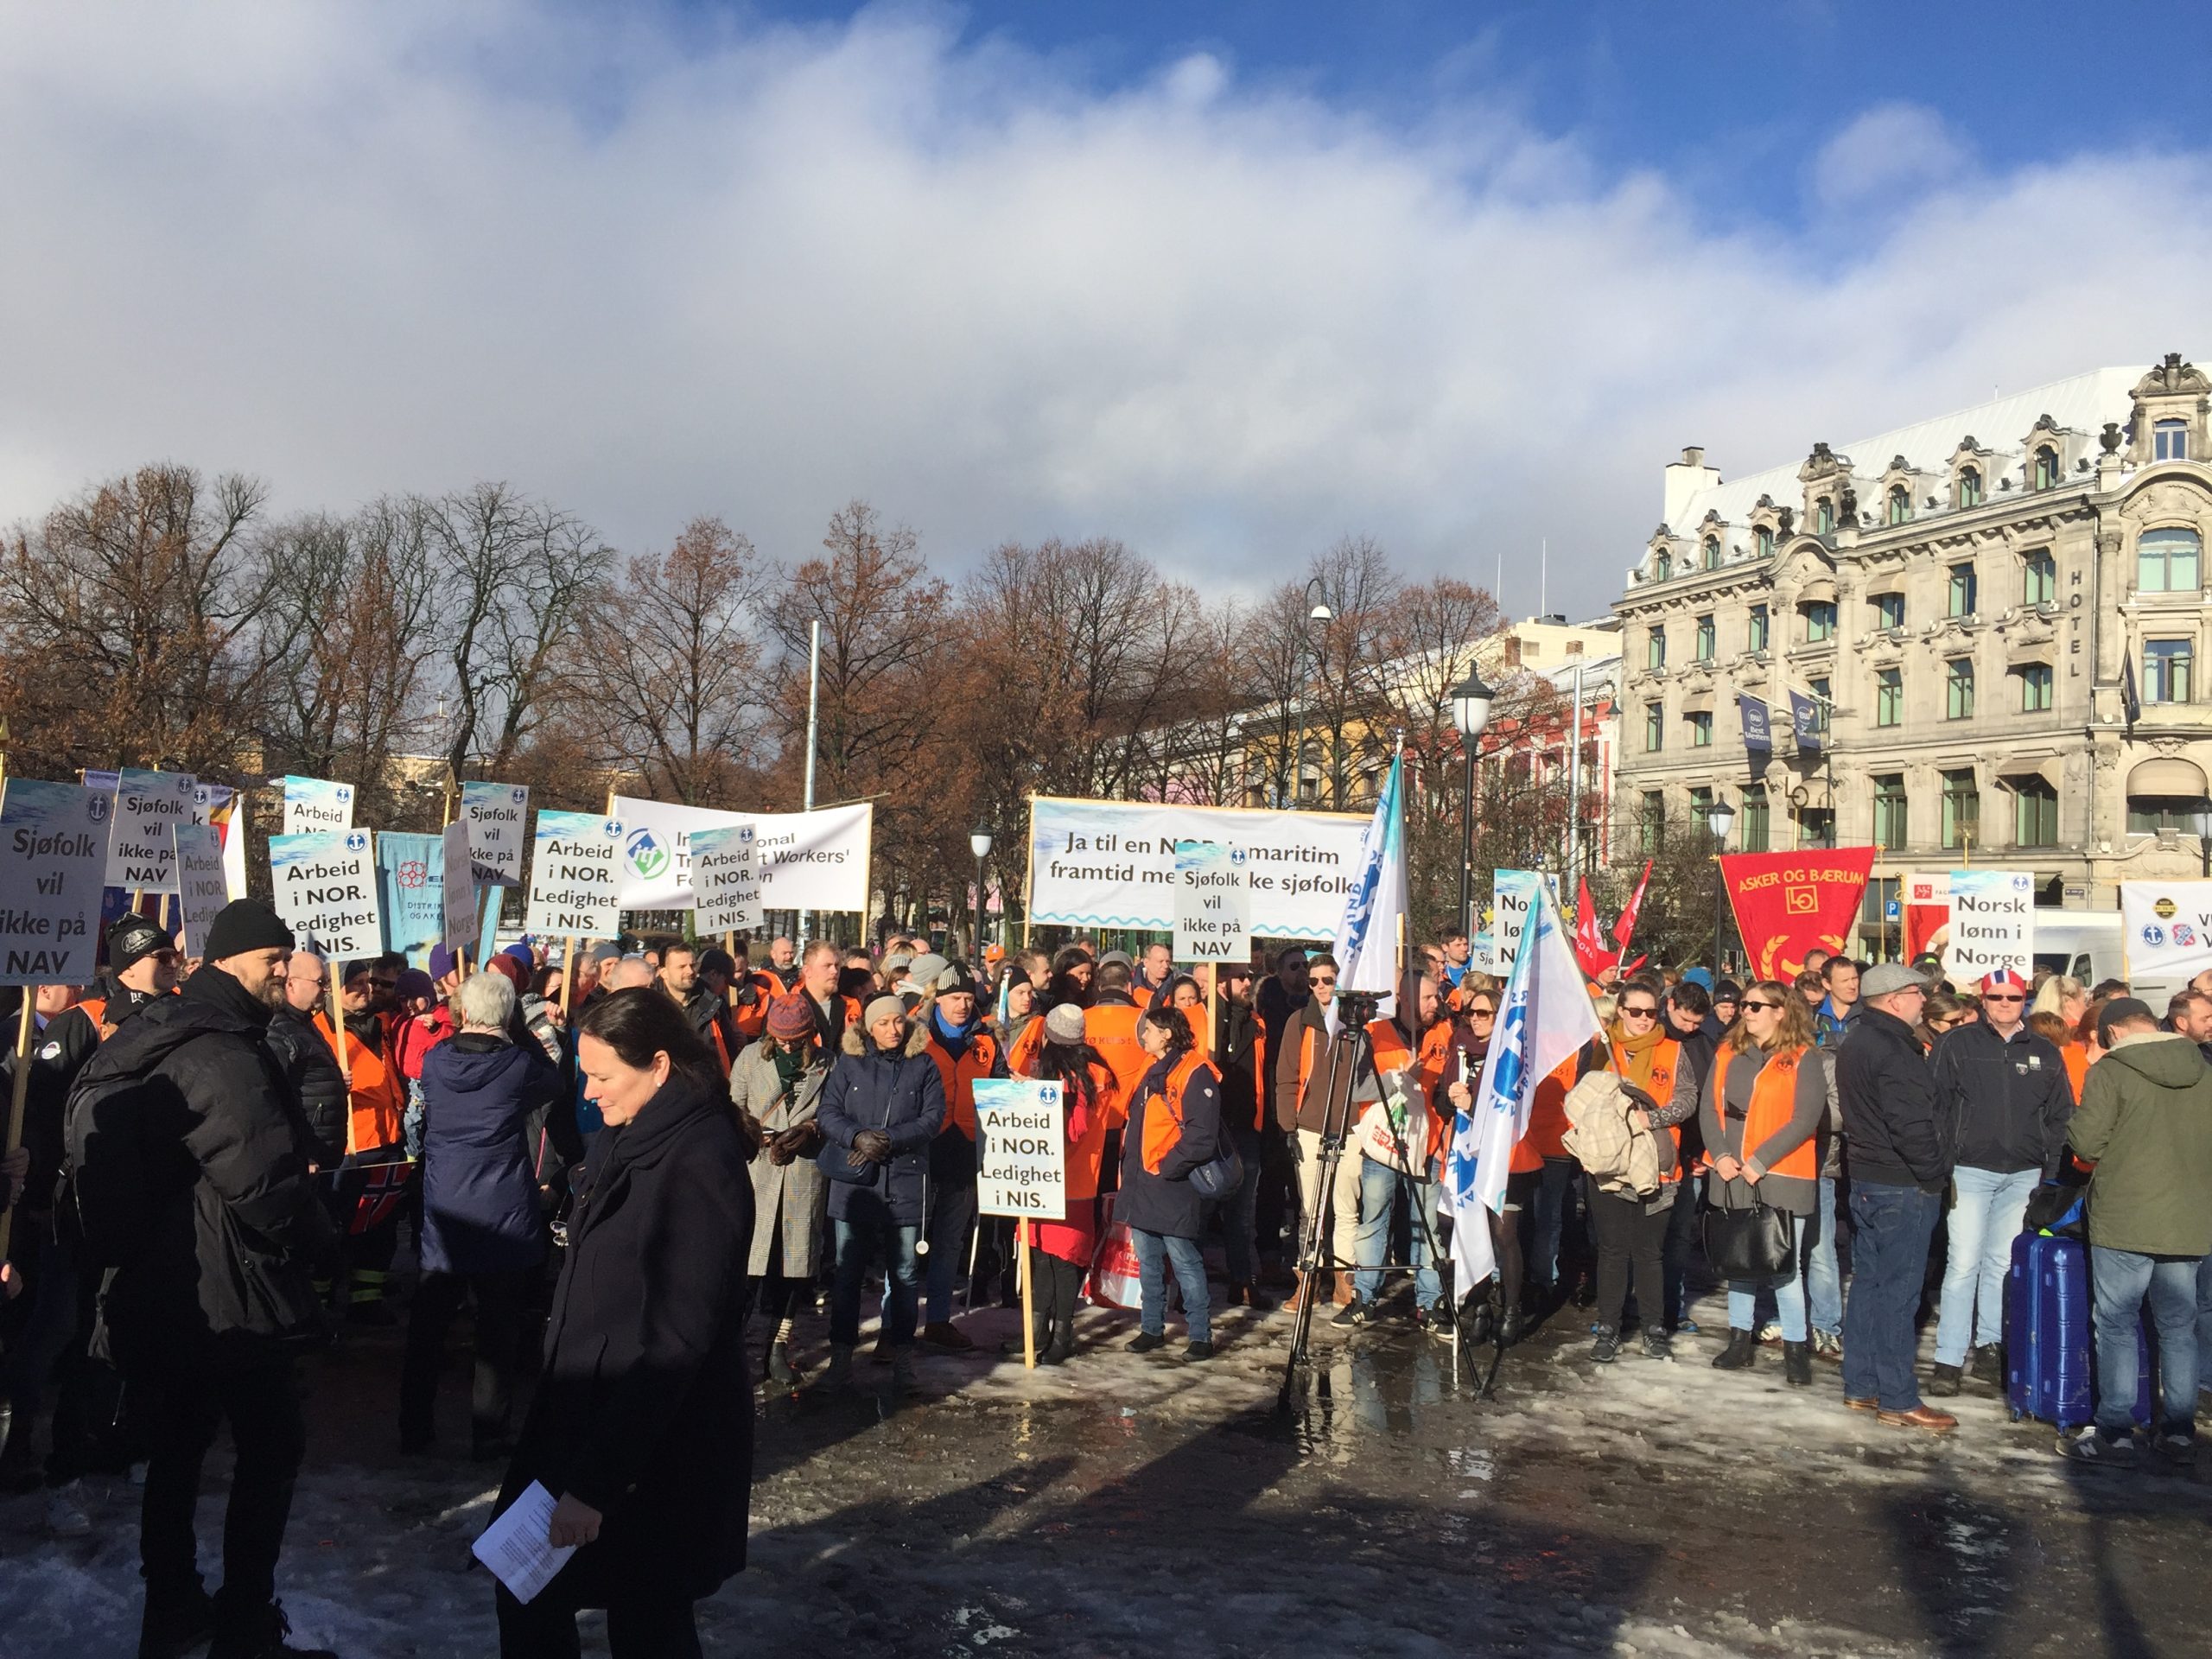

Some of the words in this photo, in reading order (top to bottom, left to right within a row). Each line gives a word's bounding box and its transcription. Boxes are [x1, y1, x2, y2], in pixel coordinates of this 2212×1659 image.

[2070, 570, 2082, 677] HOTEL
[126, 797, 184, 816] Sjøfolk
[293, 803, 343, 823] Arbeid
[469, 806, 518, 823] Sjøfolk
[143, 822, 162, 836] vil
[484, 829, 500, 841] vil
[12, 829, 97, 861] Sjøfolk
[118, 843, 154, 860] ikke
[546, 840, 613, 860] Arbeid
[1065, 831, 1087, 854] Ja
[1095, 834, 1117, 852] til
[1125, 840, 1151, 854] en
[1249, 844, 1339, 865] maritim
[184, 855, 219, 871] Arbeid
[469, 847, 493, 861] kke
[497, 849, 514, 865] på
[701, 849, 750, 868] Arbeid
[773, 849, 850, 865] Workers'
[125, 867, 168, 882] NAV
[286, 859, 360, 881] Arbeid
[471, 868, 505, 881] NAV
[549, 864, 554, 879] i
[561, 865, 614, 884] NOR.
[705, 875, 709, 887] i
[714, 869, 754, 887] NOR.
[1050, 861, 1135, 882] framtid
[1141, 870, 1175, 884] me
[1281, 874, 1353, 896] sjøfolk
[36, 871, 64, 895] vil
[196, 880, 225, 897] NOR.
[1185, 871, 1240, 889] Sjøfolk
[1738, 872, 1781, 893] ASKER
[1783, 869, 1806, 883] OG
[1809, 868, 1865, 886] BÆRUM
[293, 891, 298, 906] i
[307, 885, 367, 905] NOR.
[533, 887, 619, 910] Ledighet
[696, 889, 760, 909] Ledighet
[1203, 895, 1222, 910] vil
[1957, 895, 2027, 913] Norsk
[1889, 902, 1897, 915] P
[57, 912, 86, 943] på
[283, 911, 376, 933] Ledighet
[546, 912, 551, 927] i
[558, 913, 599, 930] NIS.
[709, 915, 714, 927] i
[719, 910, 750, 926] NIS.
[1183, 918, 1217, 933] ikke
[1223, 918, 1242, 936] på
[1961, 922, 2008, 939] lønn
[2017, 924, 2021, 939] i
[314, 936, 360, 957] NIS.
[1192, 941, 1232, 956] NAV
[6, 950, 70, 975] NAV
[1955, 947, 2026, 969] Norge
[986, 1111, 1051, 1129] Arbeid
[991, 1137, 995, 1154] i
[1002, 1138, 1055, 1156] NOR.
[981, 1164, 1062, 1185] Ledighet
[995, 1190, 1000, 1205] i
[1007, 1191, 1046, 1209] NIS.
